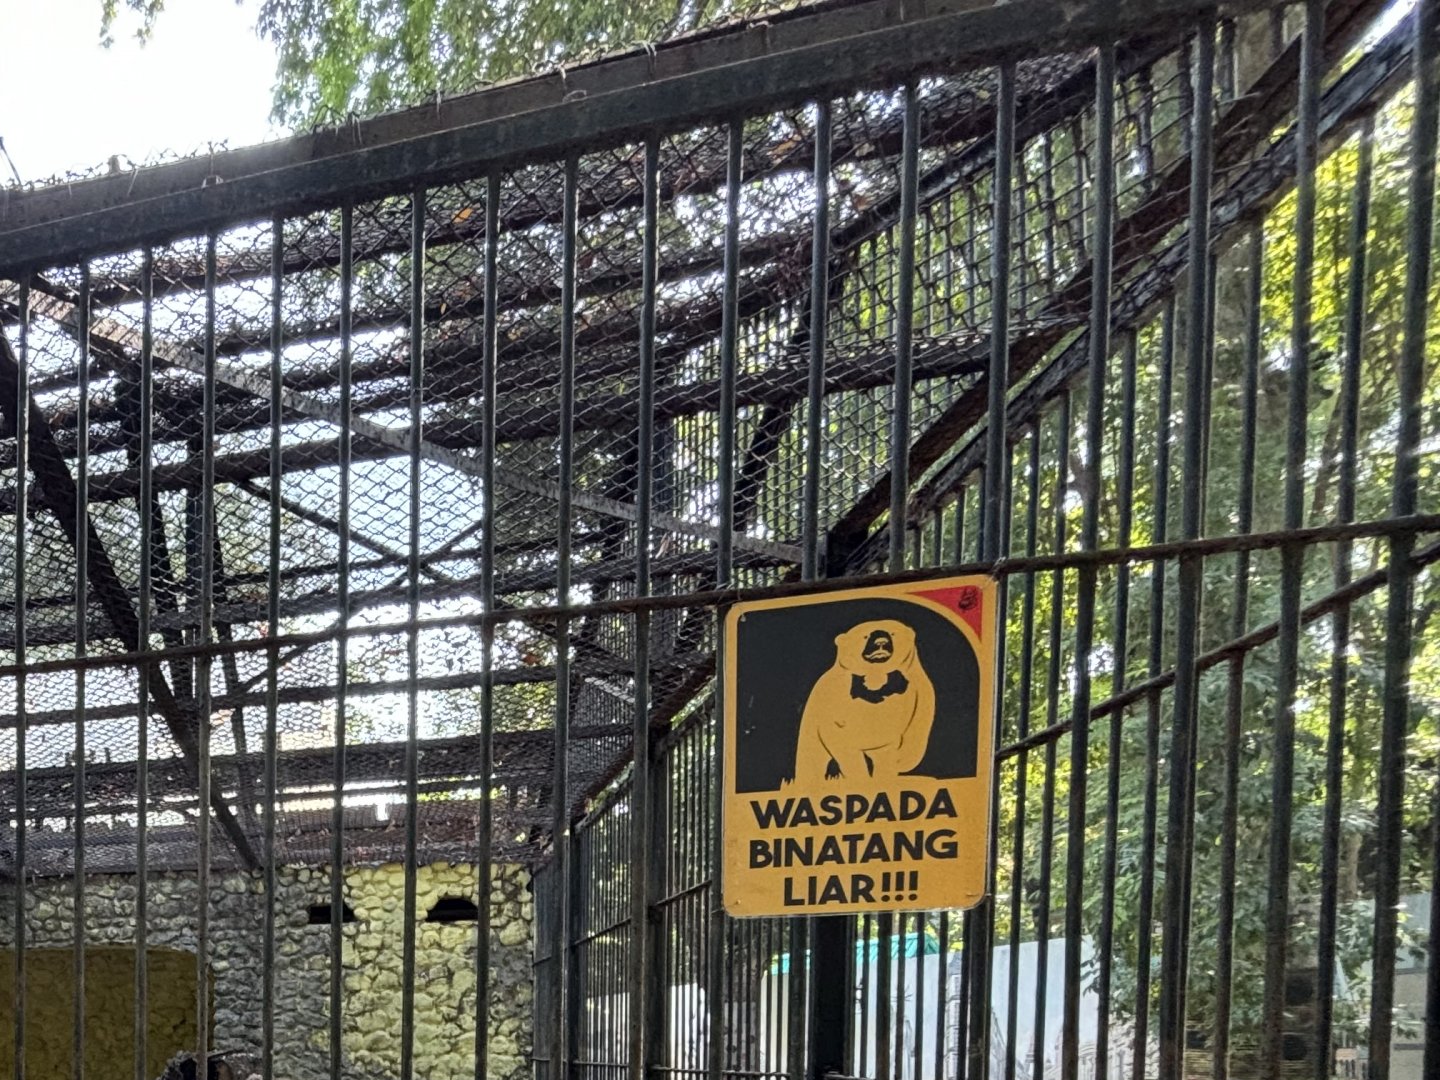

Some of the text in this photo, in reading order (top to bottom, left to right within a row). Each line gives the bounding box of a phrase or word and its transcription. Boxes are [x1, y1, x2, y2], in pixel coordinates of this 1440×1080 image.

[750, 788, 958, 829] WASPADA
[749, 830, 958, 869] BINATANG
[783, 871, 919, 907] LIAR!!!
